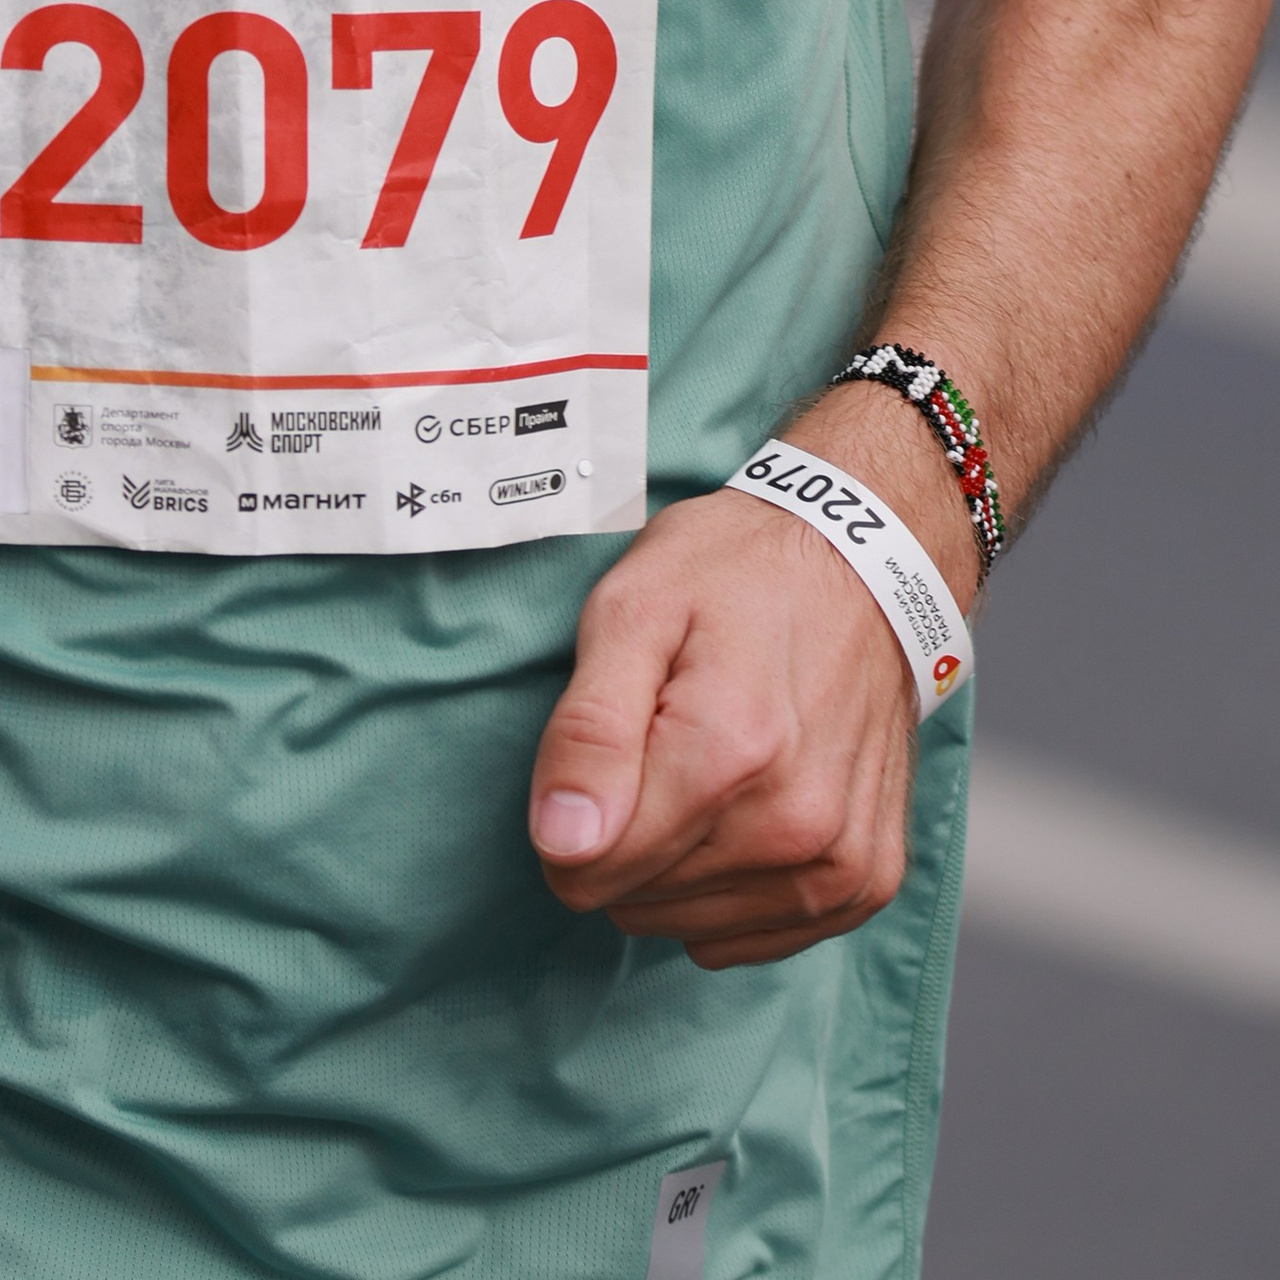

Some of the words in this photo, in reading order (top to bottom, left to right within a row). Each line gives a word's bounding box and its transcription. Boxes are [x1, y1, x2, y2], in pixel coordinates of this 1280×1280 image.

[101, 407, 180, 421] Департамент
[271, 406, 381, 432] МОСКОВСКИЙ
[449, 415, 511, 437] СБЕР
[519, 409, 559, 430] Прайм
[101, 423, 142, 434] спорта
[101, 436, 142, 448] города
[146, 437, 191, 450] Москвы
[271, 433, 323, 454] СПОРТ
[497, 476, 549, 501] WINLINE
[744, 452, 887, 545] 22079
[153, 495, 209, 513] BRICS
[885, 556, 942, 651] МОСКОВСКИЙ
[911, 571, 953, 643] МАРАФОН
[893, 588, 932, 657] СБЕРПРАЙМ
